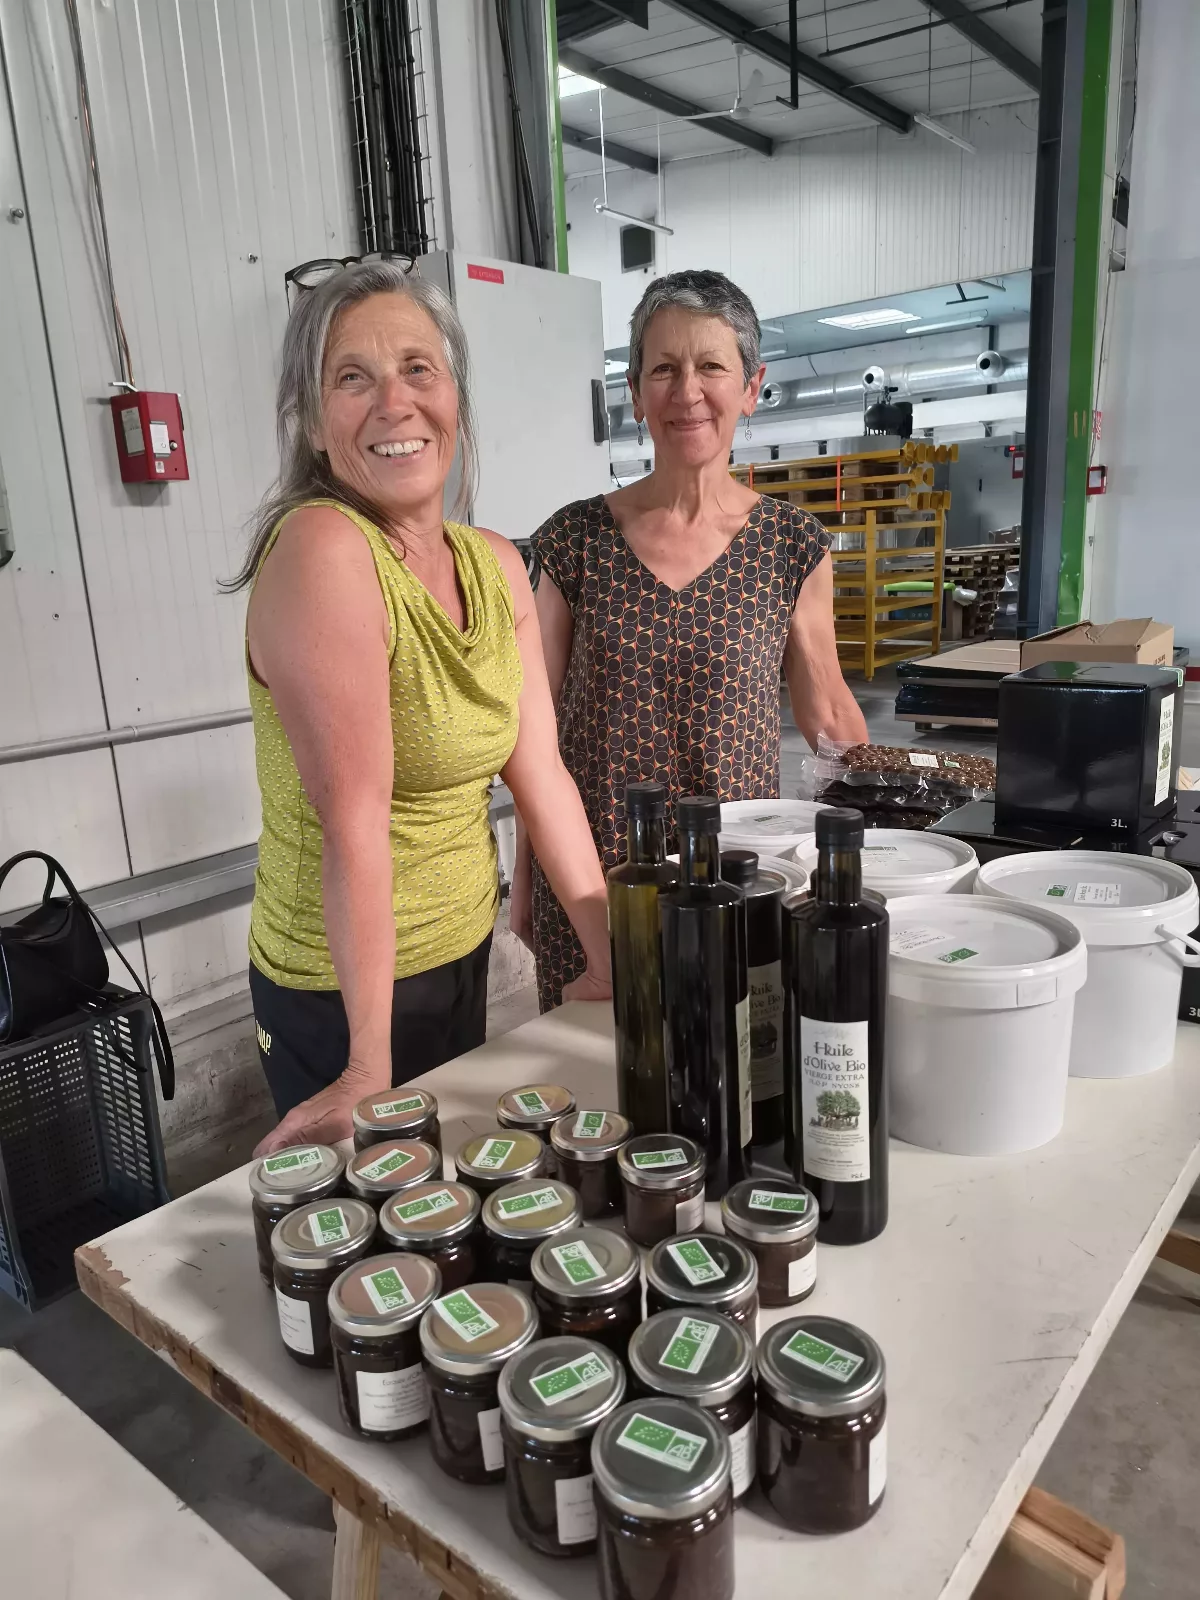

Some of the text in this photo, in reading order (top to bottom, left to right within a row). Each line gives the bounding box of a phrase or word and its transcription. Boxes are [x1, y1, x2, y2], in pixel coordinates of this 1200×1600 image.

[813, 1041, 853, 1056] Huile
[804, 1055, 866, 1071] d'Olive Bio
[804, 1068, 865, 1082] VIERGE EXTRA
